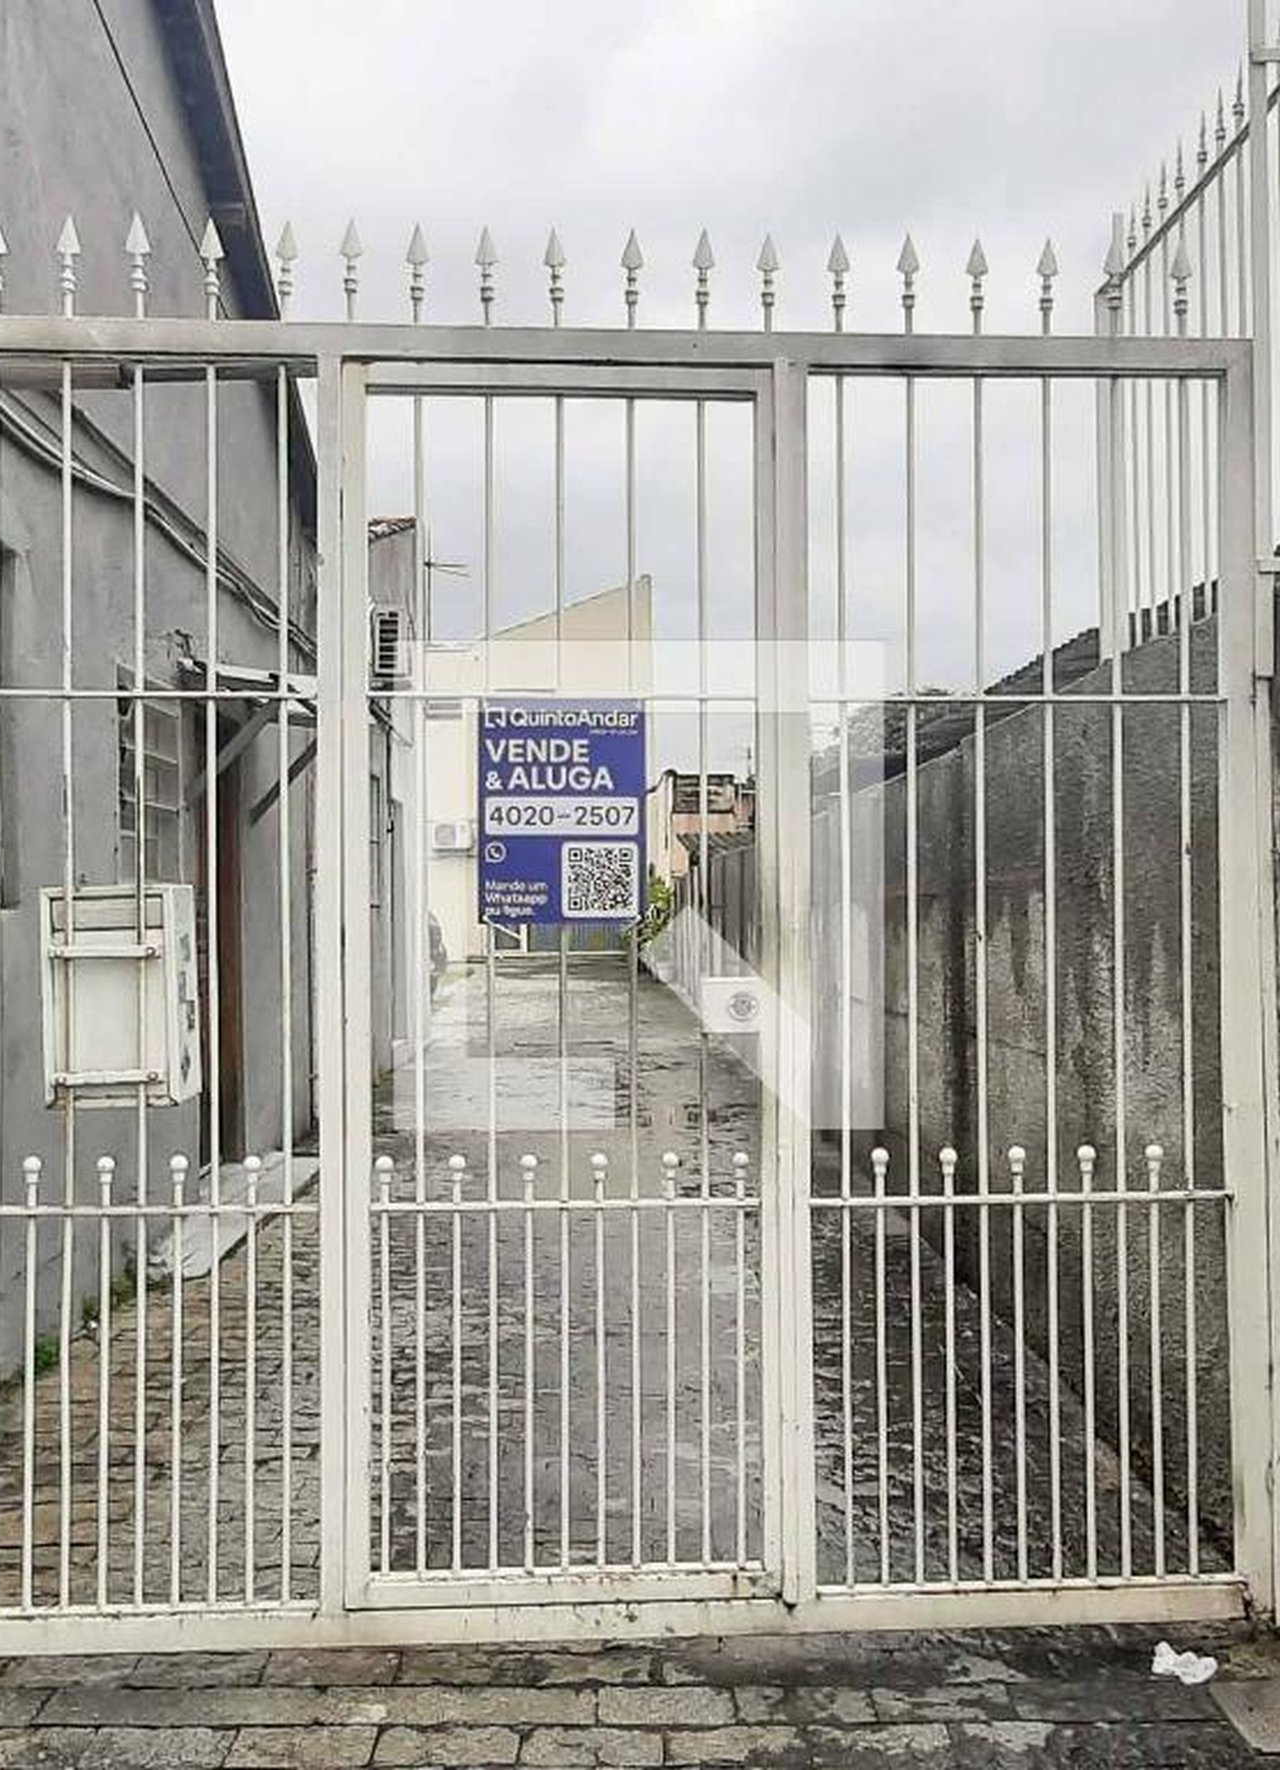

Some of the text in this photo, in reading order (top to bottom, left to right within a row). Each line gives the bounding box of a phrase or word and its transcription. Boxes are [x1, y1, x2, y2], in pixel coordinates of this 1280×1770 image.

[510, 708, 638, 728] QuintoAndar
[485, 738, 590, 763] VENDE
[485, 765, 614, 791] & ALUGA
[489, 805, 636, 826] 4020-2507
